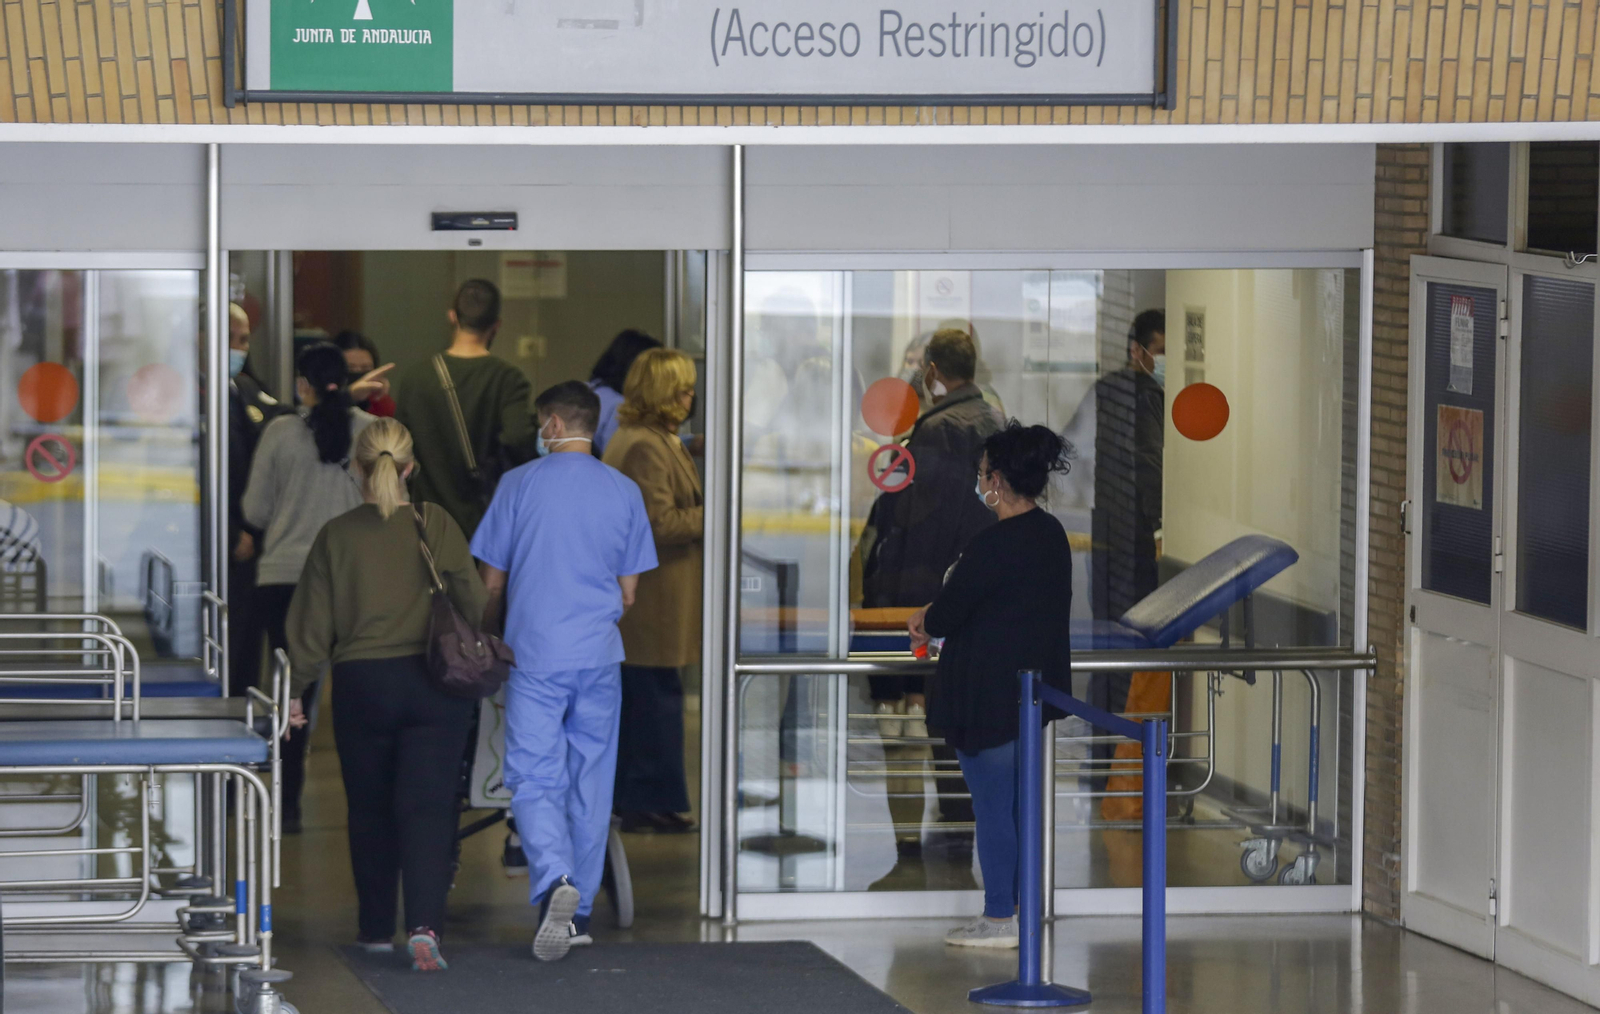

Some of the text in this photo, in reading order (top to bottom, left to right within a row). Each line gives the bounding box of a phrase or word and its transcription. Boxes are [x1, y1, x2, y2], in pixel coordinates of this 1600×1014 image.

[292, 28, 432, 44] JUNTA DE ANDALUCIA
[710, 8, 1106, 68] (Acceso Restringido)
